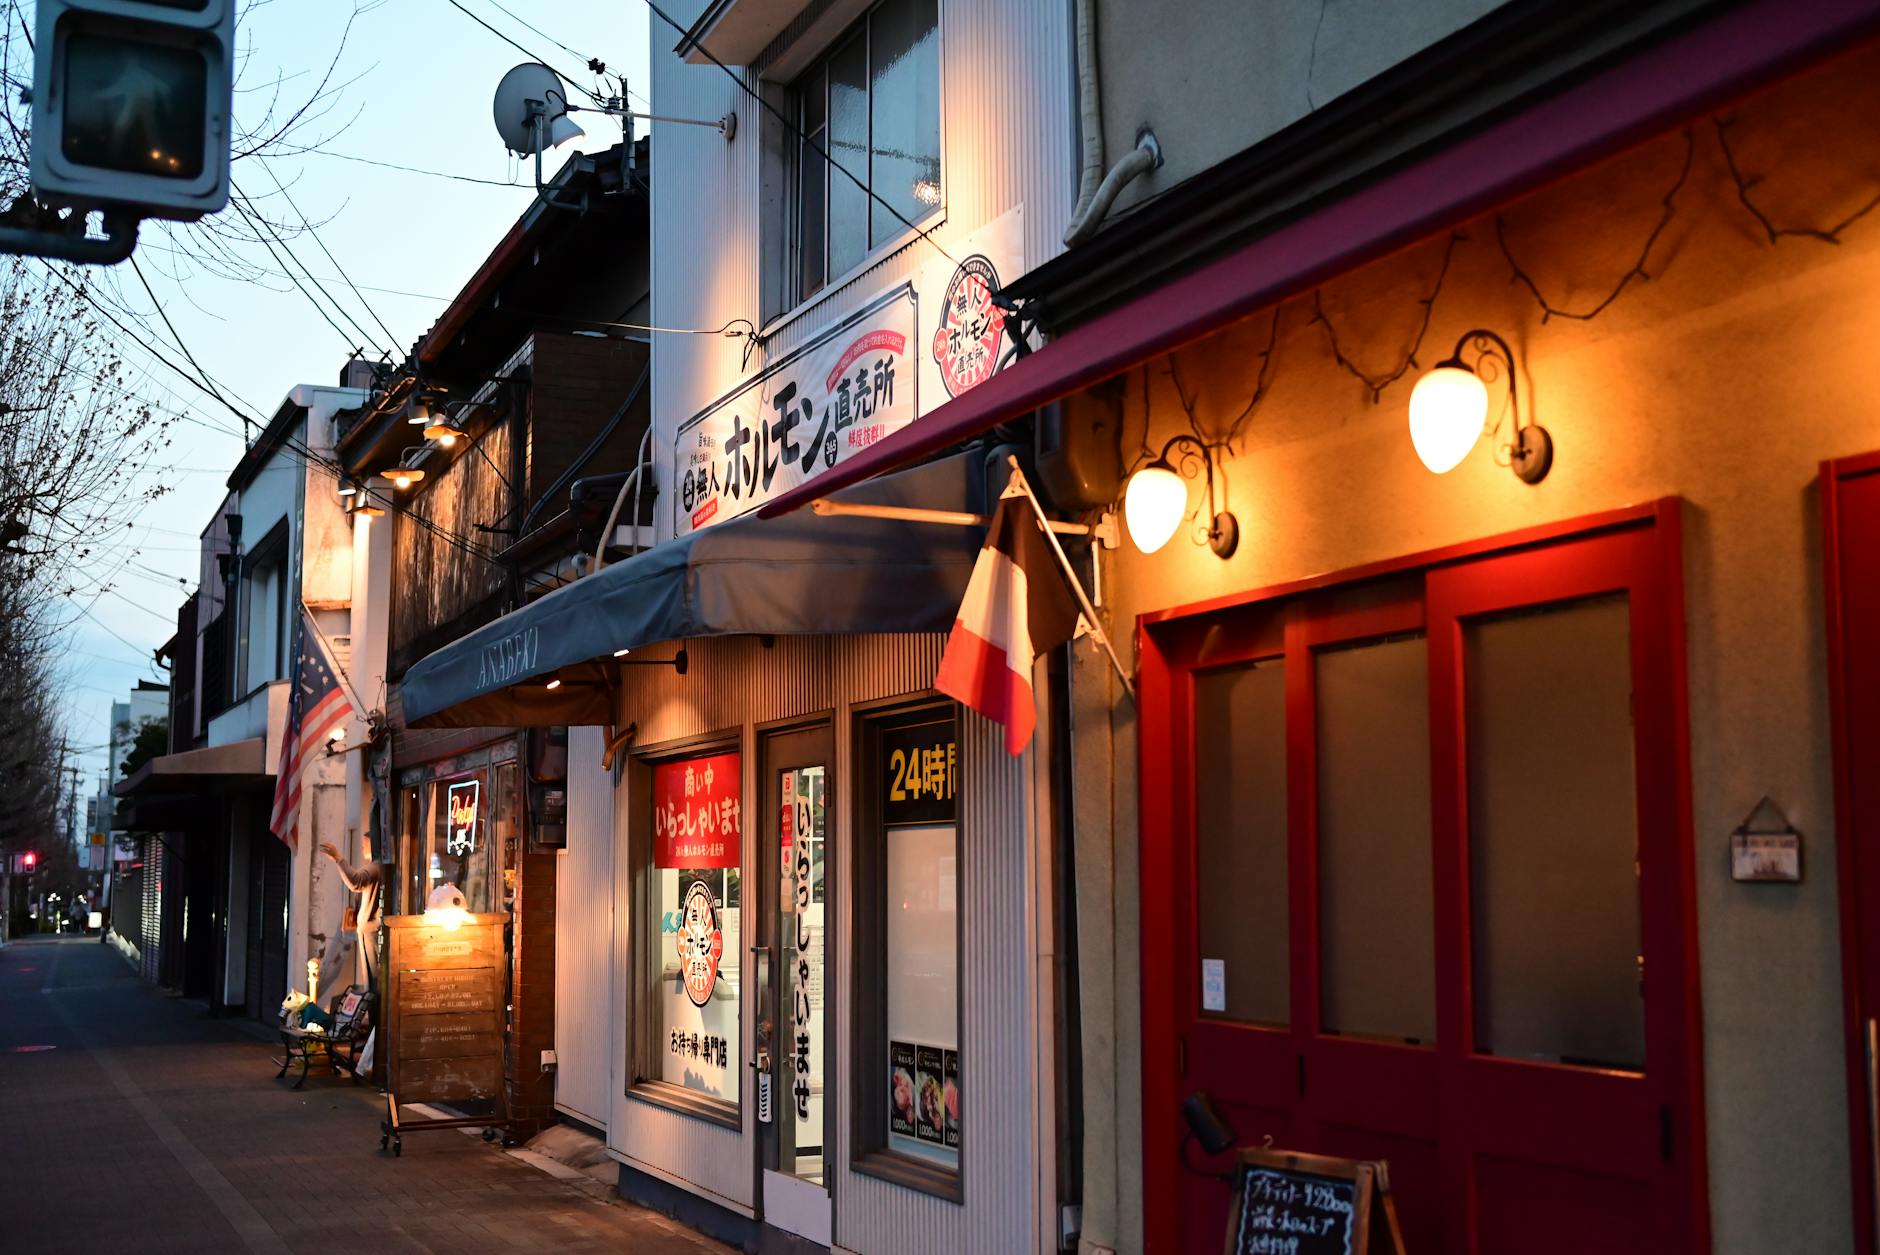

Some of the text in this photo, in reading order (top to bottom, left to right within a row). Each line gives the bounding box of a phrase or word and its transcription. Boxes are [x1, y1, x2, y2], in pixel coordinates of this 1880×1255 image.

[957, 287, 981, 318] 無人
[949, 313, 992, 354] ホルモン
[957, 347, 984, 374] 直売所
[684, 762, 714, 798] 商い中
[795, 801, 811, 1120] いらっしゃいませ
[671, 1028, 727, 1069] お持ち帰り専門店
